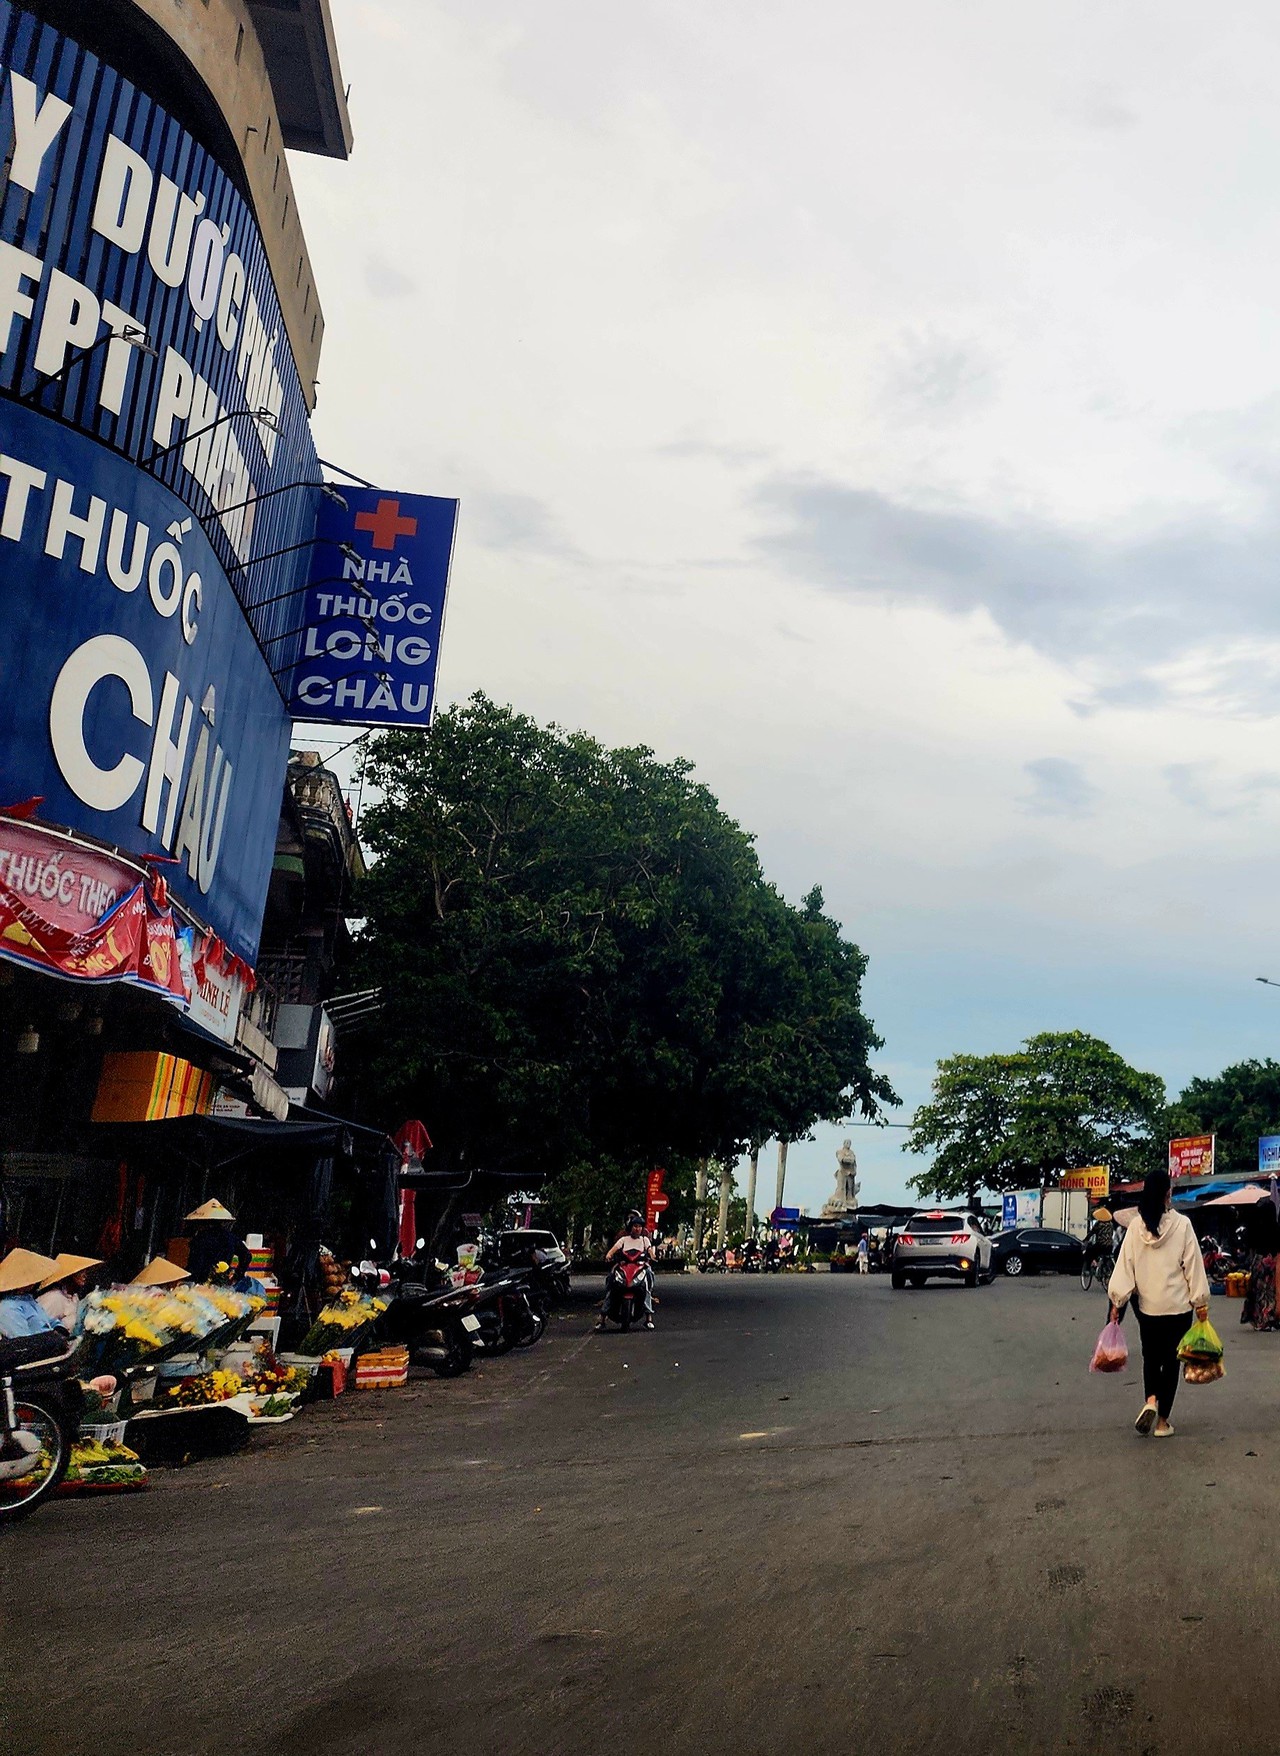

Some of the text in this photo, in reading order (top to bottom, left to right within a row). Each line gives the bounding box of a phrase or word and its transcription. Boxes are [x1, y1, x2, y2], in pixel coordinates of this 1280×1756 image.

[91, 133, 247, 351] DƯỢC
[0, 238, 147, 416] FPT
[0, 454, 203, 646] THUỐC
[342, 556, 414, 586] NHÀ
[304, 627, 432, 666] LONG
[316, 592, 433, 625] THUỐC
[50, 633, 233, 895] CHÂU
[1087, 1176, 1106, 1187] NGA
